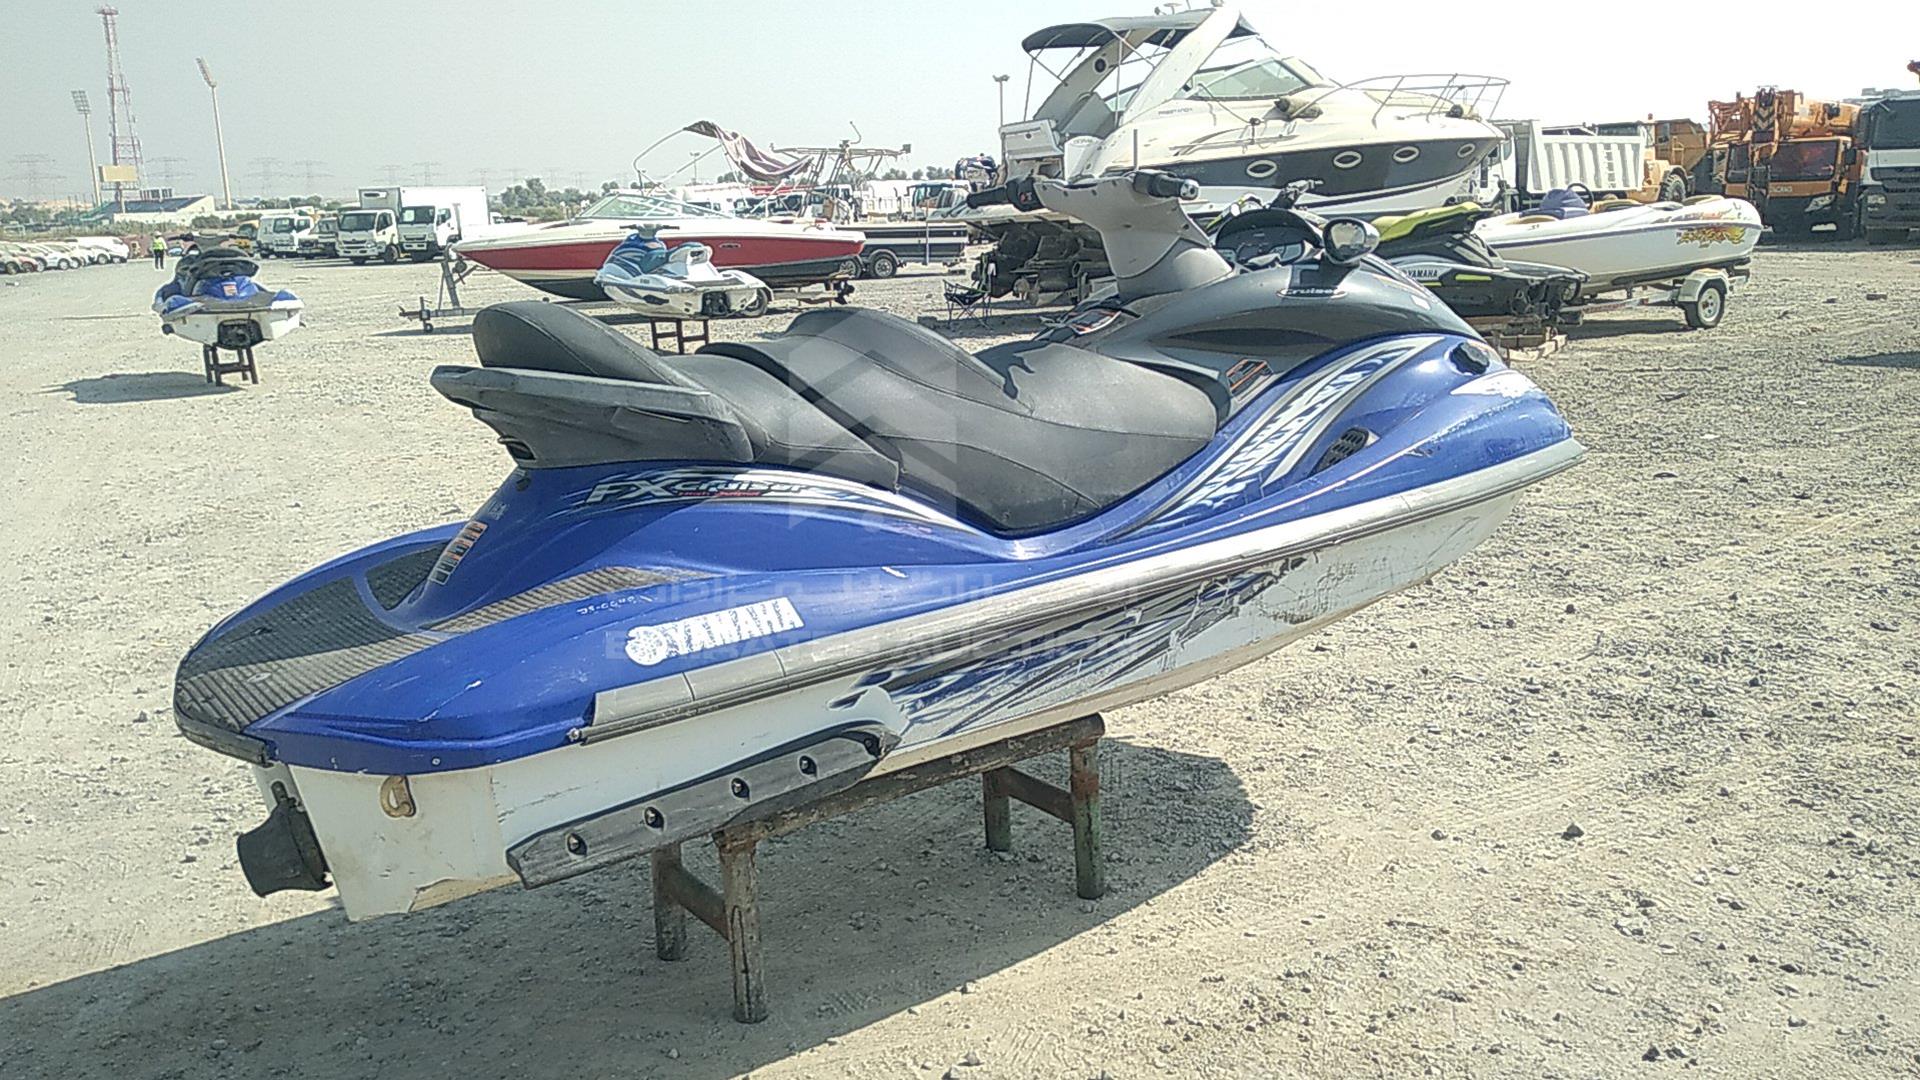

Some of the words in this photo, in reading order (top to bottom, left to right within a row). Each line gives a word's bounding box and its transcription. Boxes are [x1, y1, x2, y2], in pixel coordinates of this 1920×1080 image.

[1408, 269, 1438, 278] YAMAHA
[586, 478, 679, 503] FX
[660, 596, 804, 657] YAMAHA
